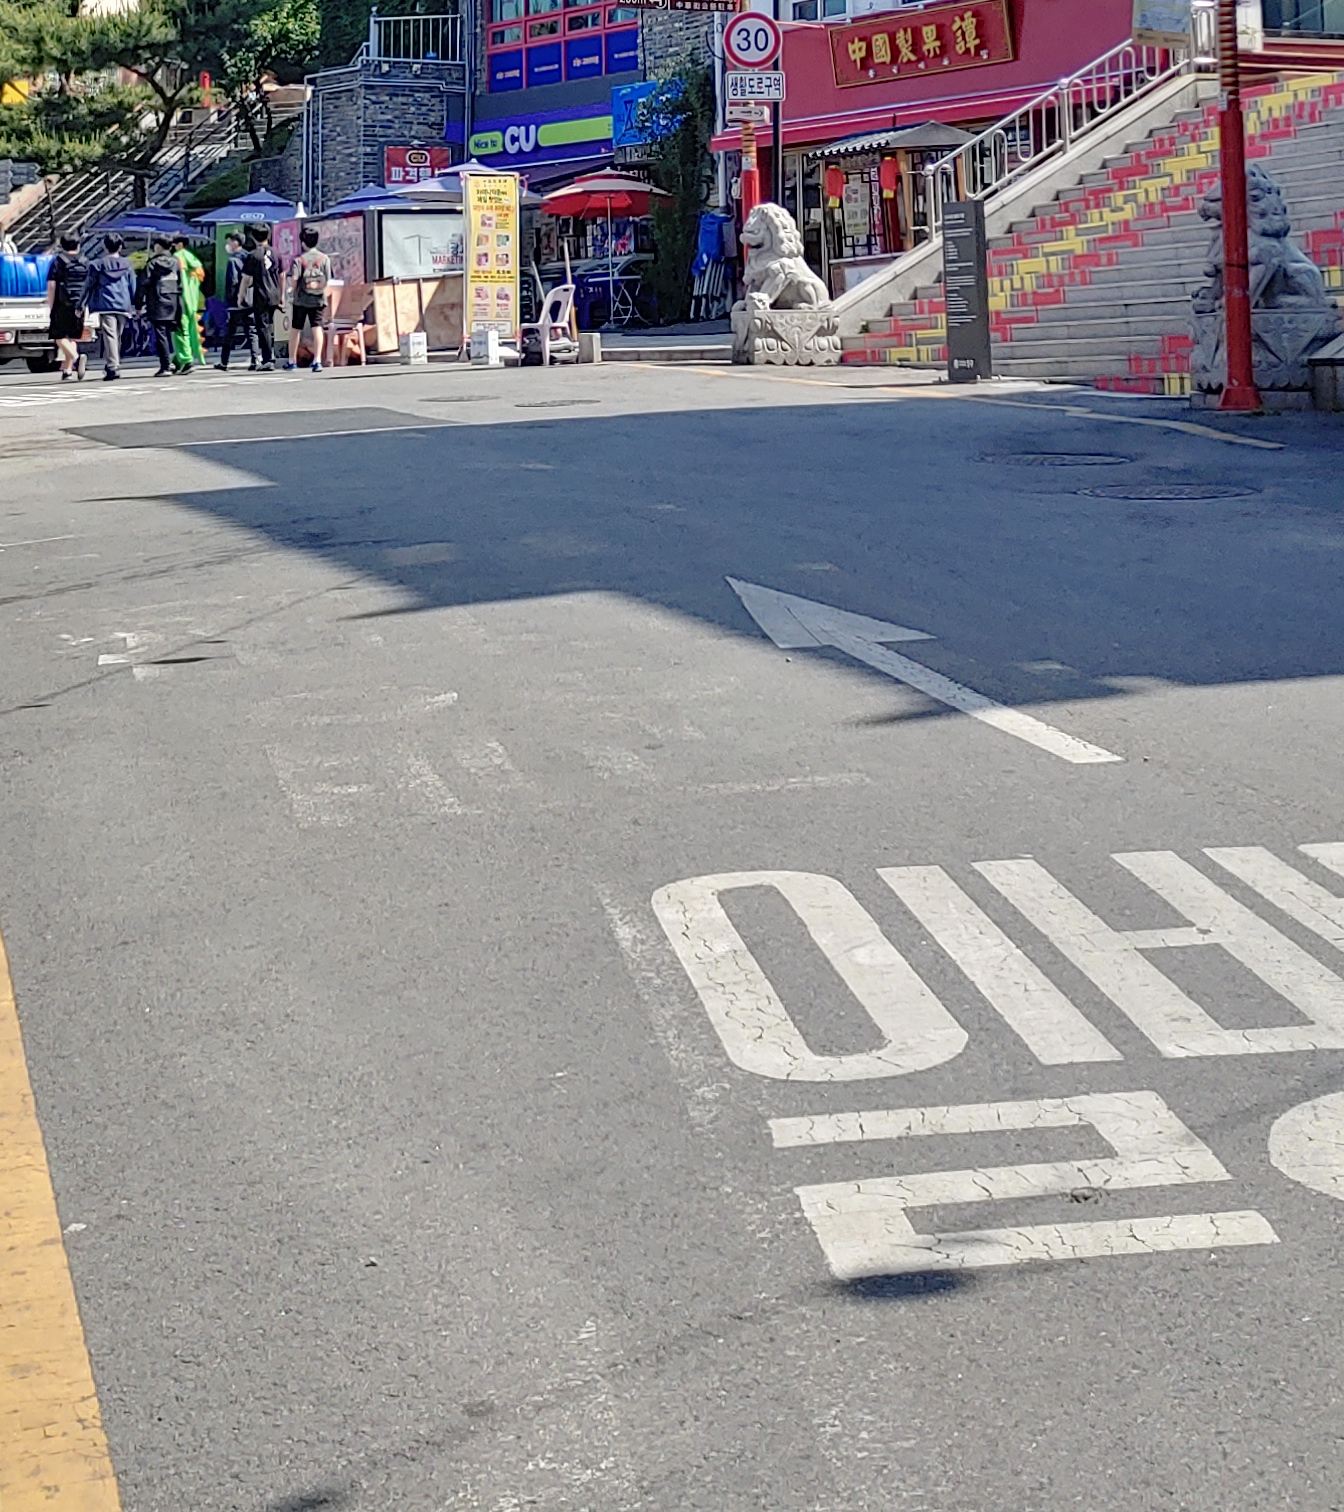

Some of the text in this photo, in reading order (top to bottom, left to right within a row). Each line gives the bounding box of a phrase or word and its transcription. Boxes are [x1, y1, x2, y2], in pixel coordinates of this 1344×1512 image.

[736, 28, 769, 51] 30
[847, 24, 981, 71] 中國製果譚
[730, 76, 781, 97] 생활도로구역
[506, 124, 537, 154] CU
